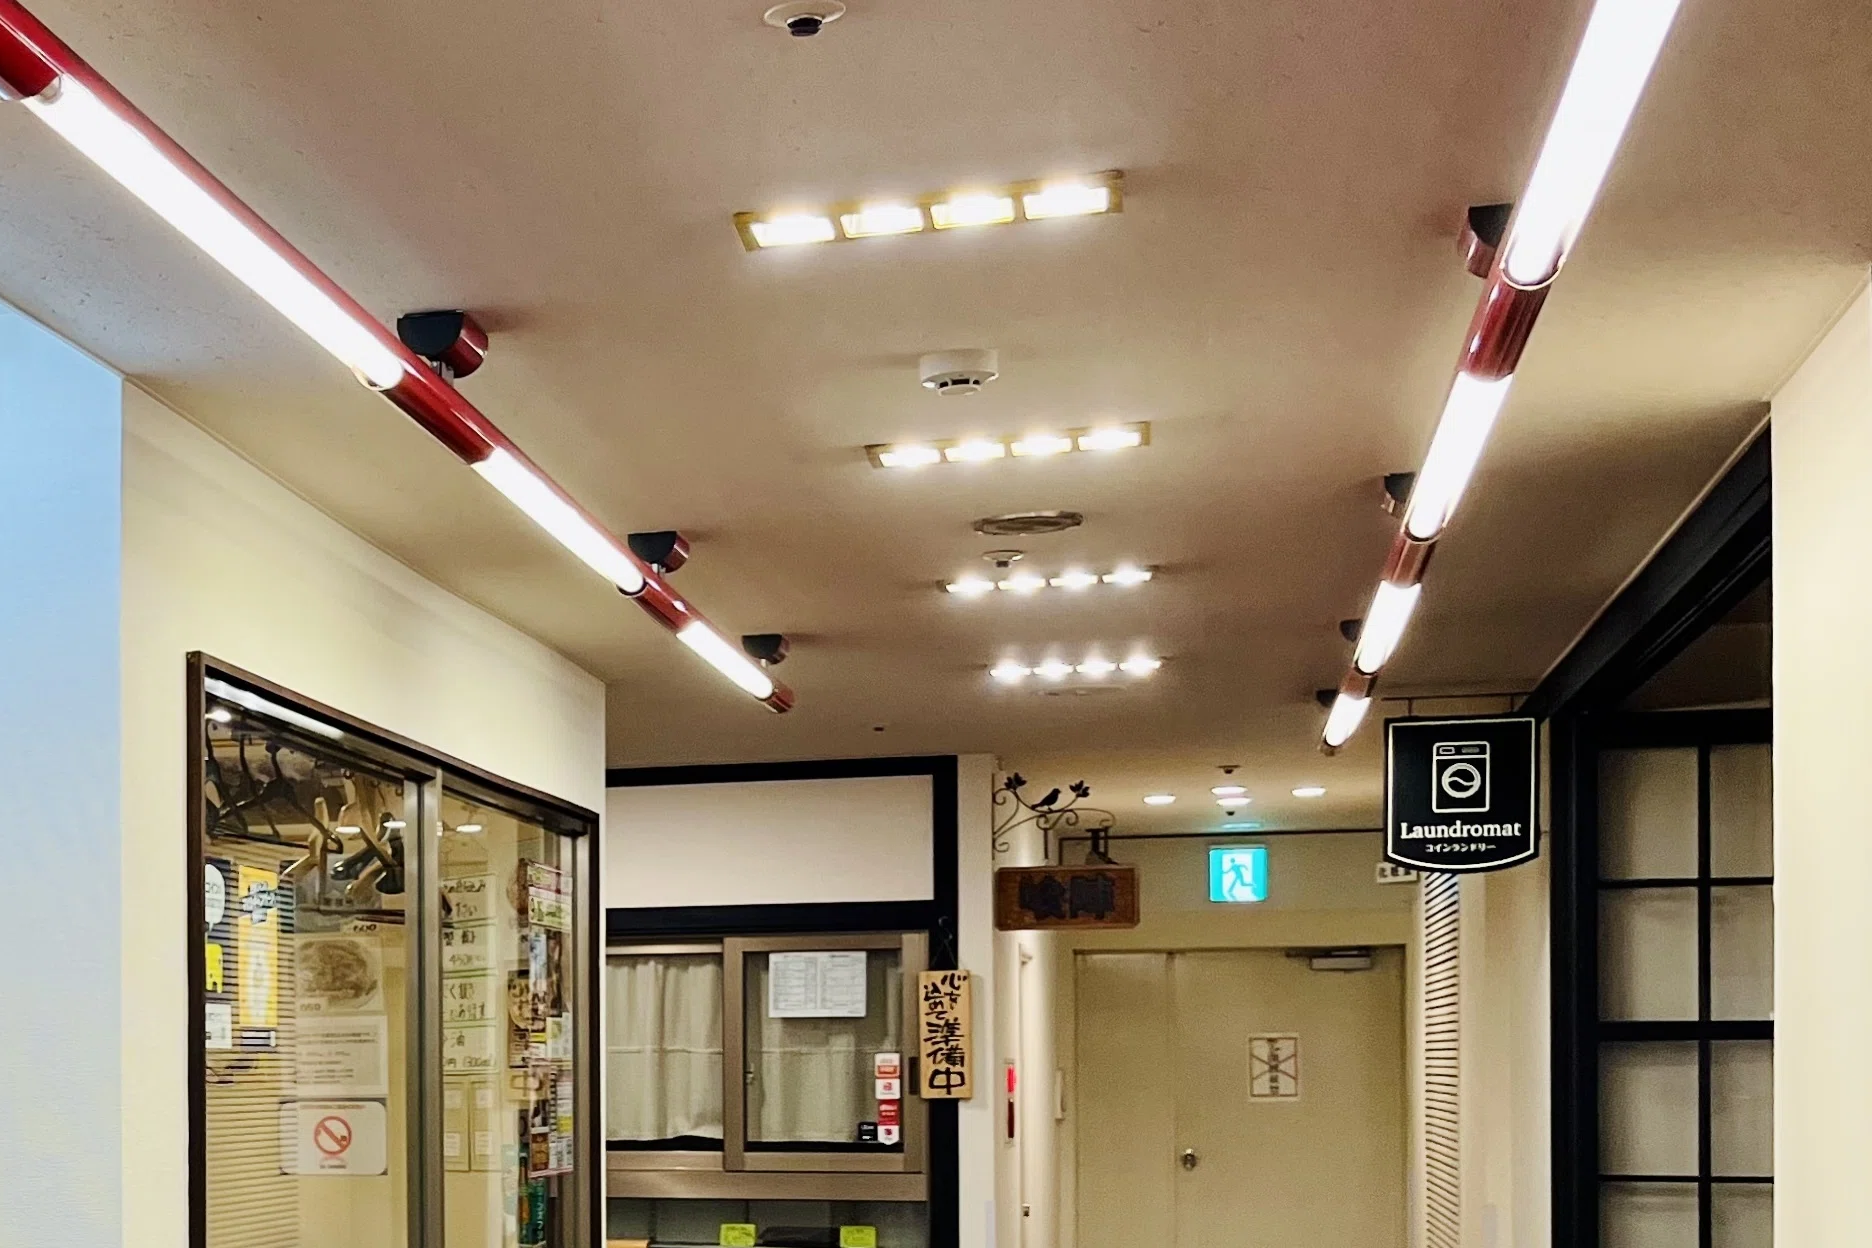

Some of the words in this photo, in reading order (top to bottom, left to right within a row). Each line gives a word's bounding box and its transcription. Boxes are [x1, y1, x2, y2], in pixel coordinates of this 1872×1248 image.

[1400, 820, 1522, 839] Laundromat
[1425, 843, 1497, 852] コインランドリー
[923, 1017, 966, 1095] 準備中
